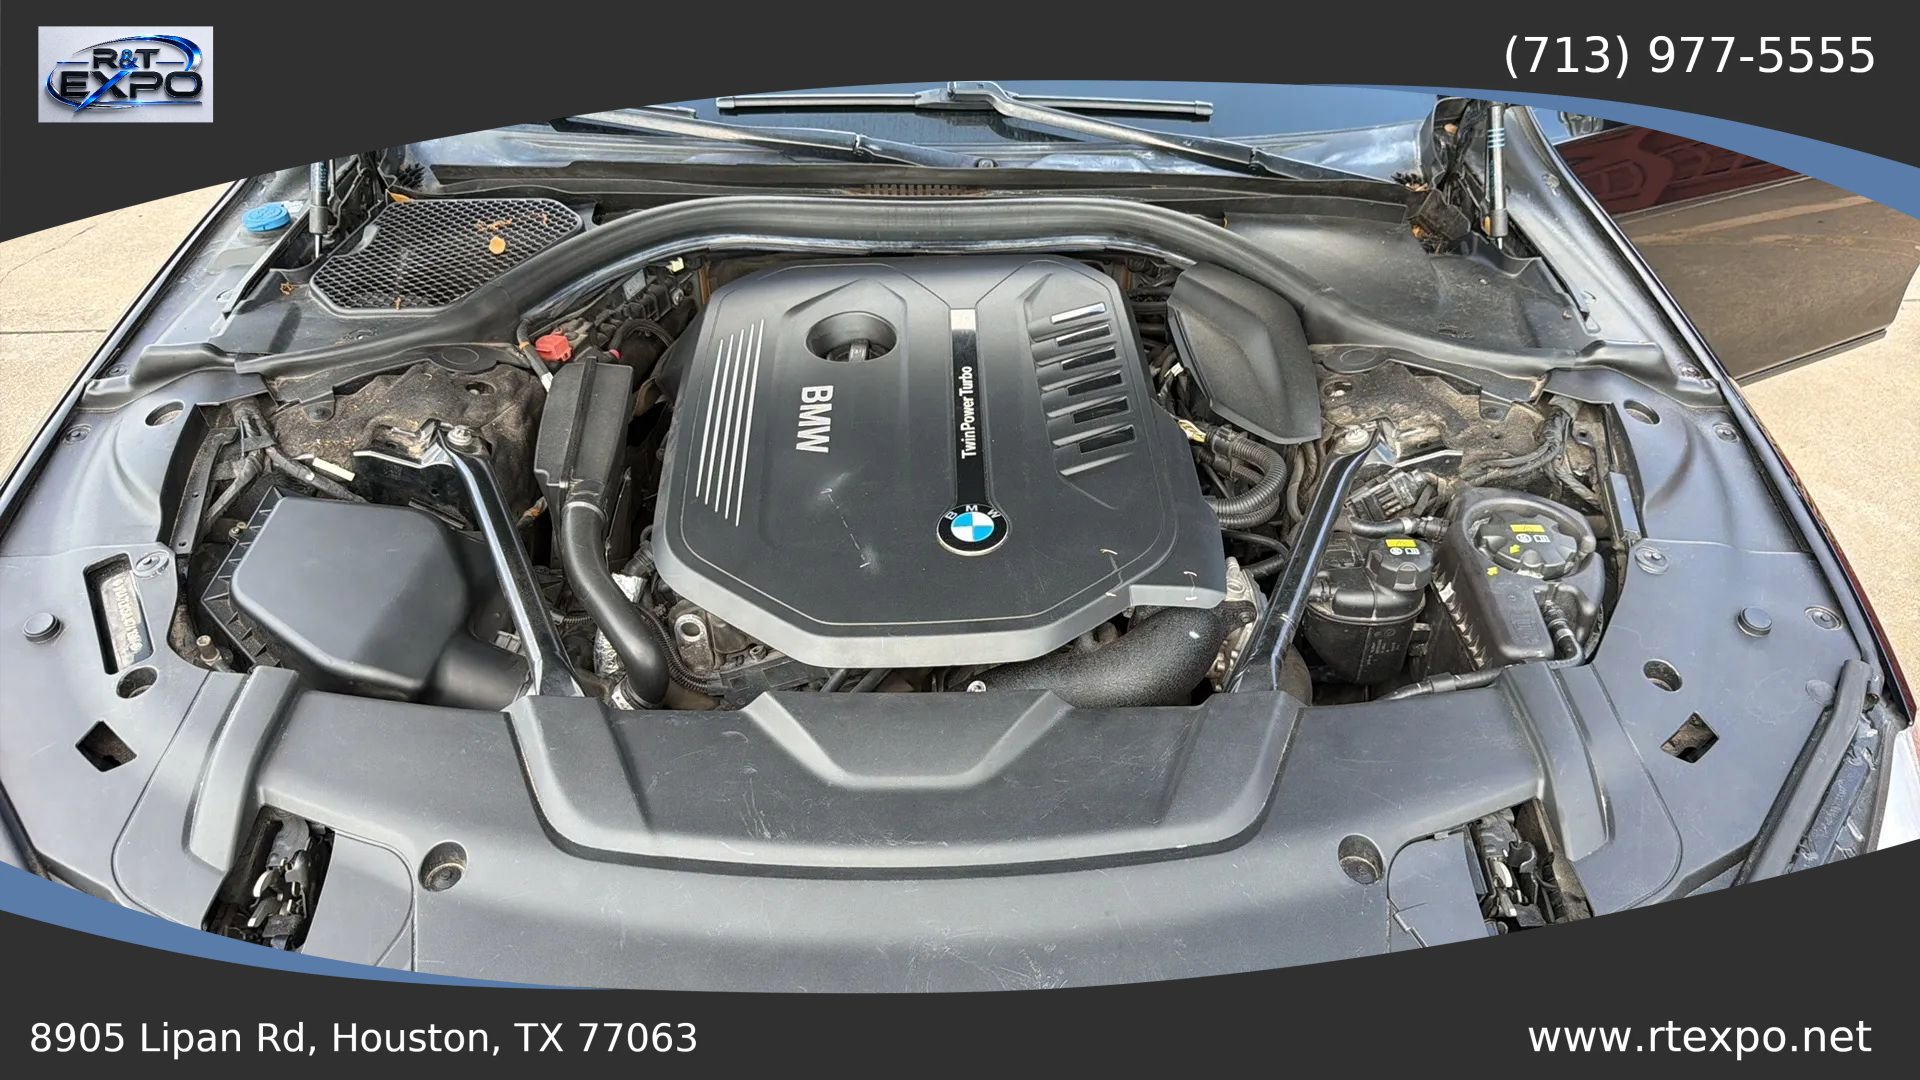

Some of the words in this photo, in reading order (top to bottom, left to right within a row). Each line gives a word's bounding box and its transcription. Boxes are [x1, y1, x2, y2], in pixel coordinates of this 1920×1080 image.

[958, 365, 974, 396] Turbo
[796, 385, 834, 453] BMW
[960, 397, 977, 459] TwinPower
[944, 504, 1001, 520] BMW
